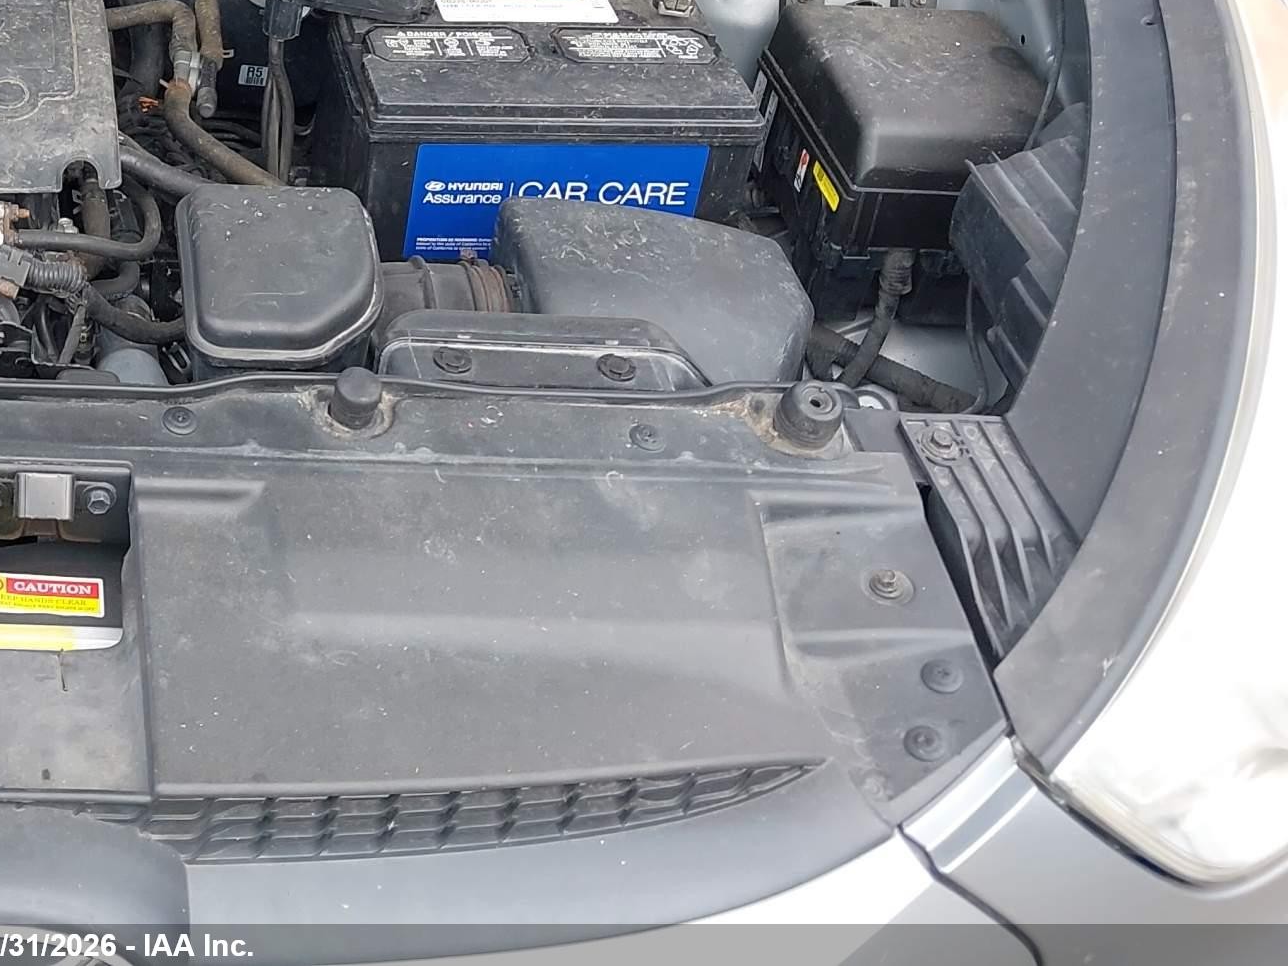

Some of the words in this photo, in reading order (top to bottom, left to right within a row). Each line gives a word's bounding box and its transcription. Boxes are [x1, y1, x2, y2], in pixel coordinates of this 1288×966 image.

[422, 192, 501, 204] Assurance
[447, 182, 503, 191] HYUNDAI
[518, 181, 588, 202] CAR
[598, 182, 689, 205] CARE
[13, 581, 92, 595] CAUTION
